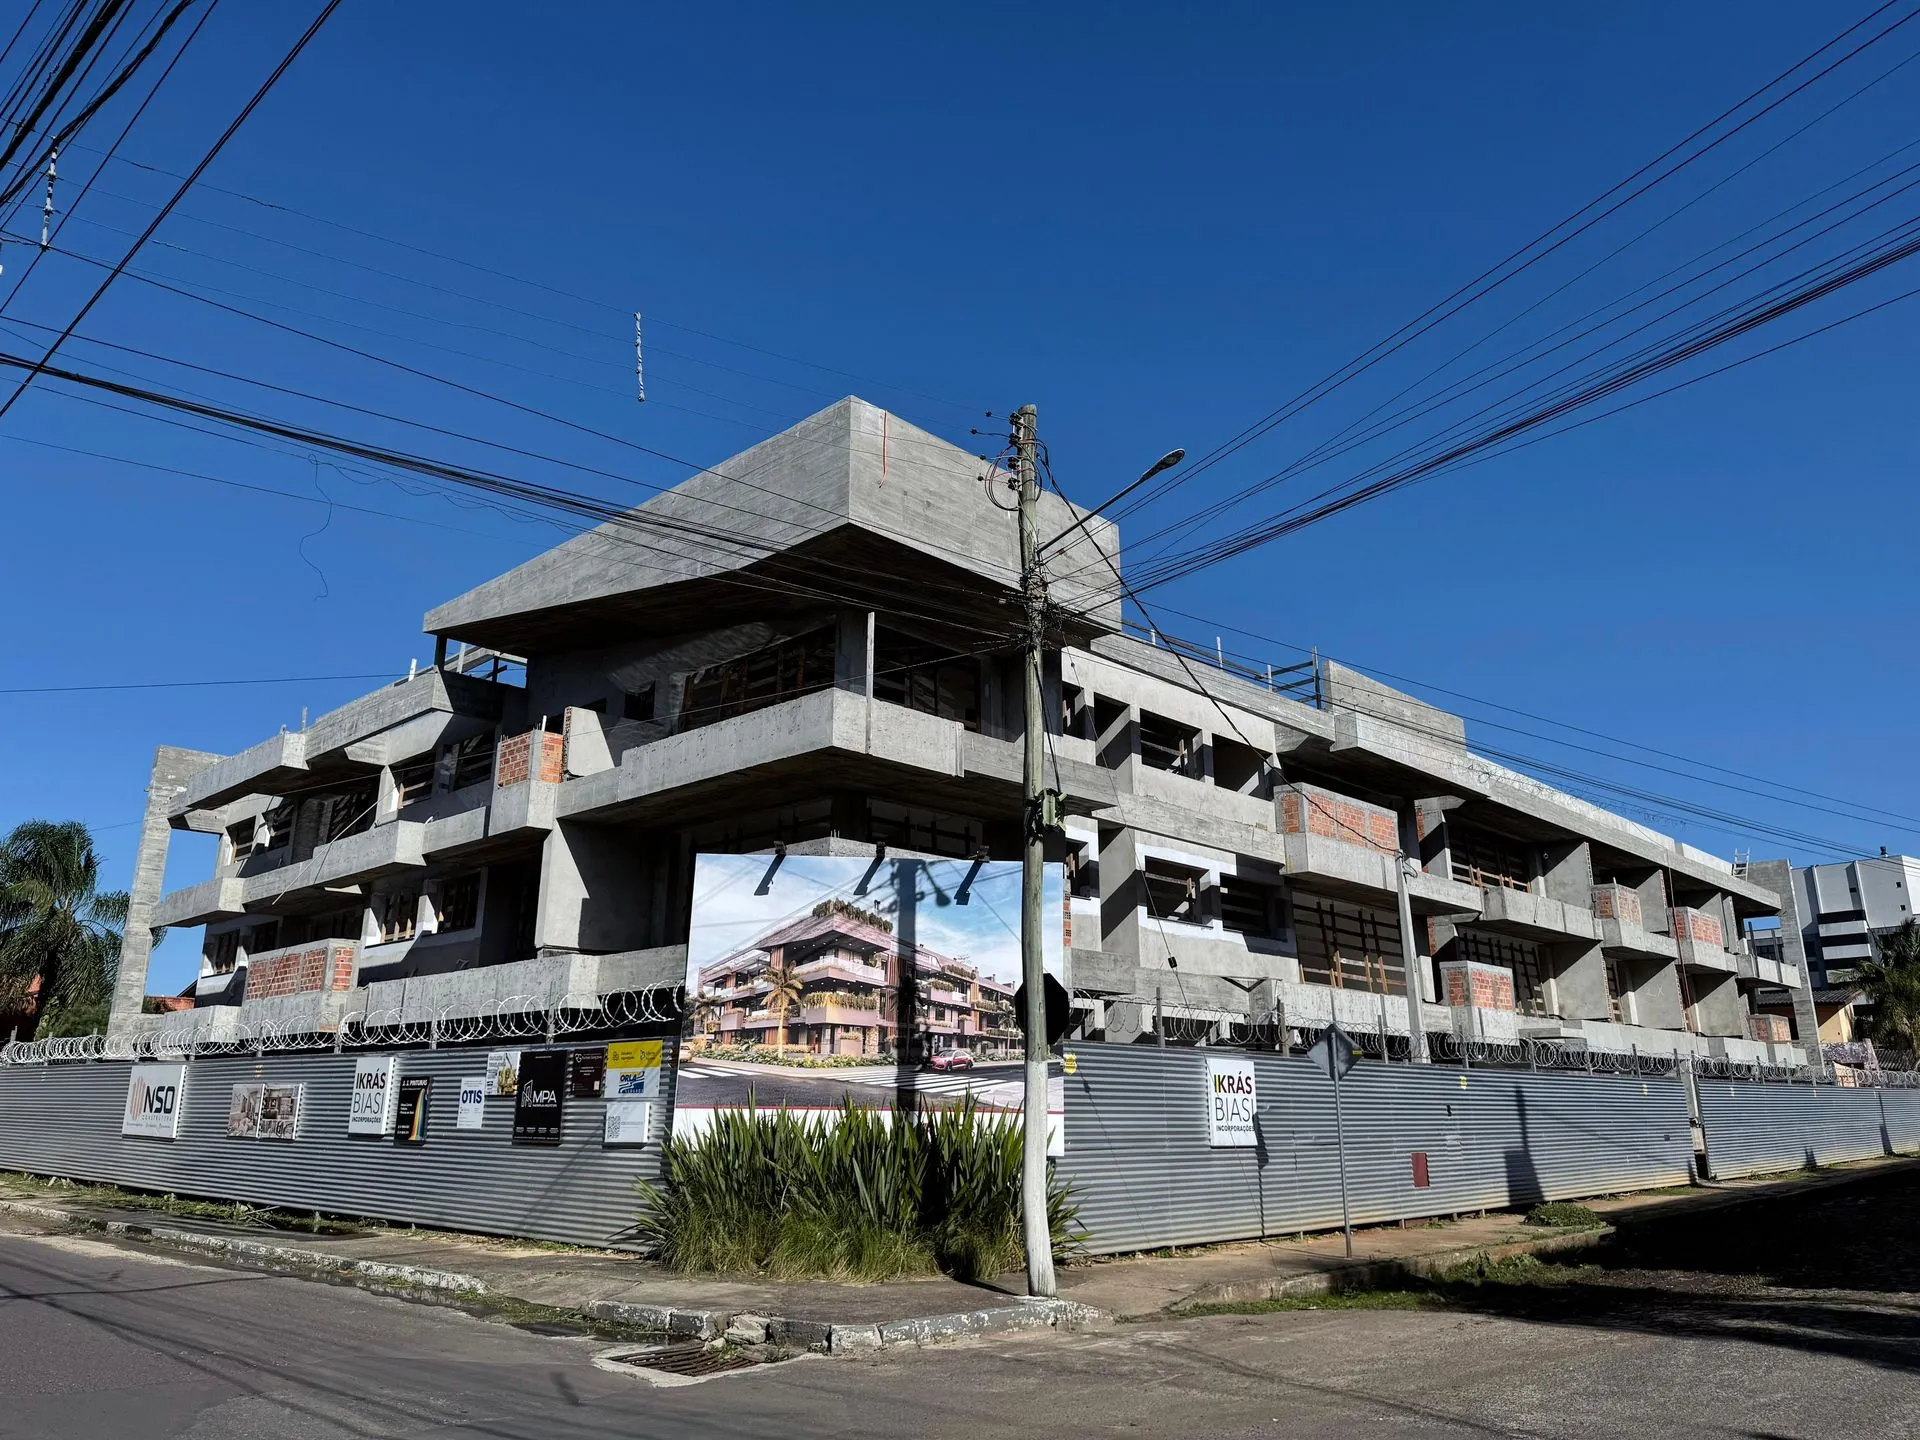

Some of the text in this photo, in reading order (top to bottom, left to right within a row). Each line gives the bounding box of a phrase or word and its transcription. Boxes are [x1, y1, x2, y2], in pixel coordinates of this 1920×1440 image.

[355, 1068, 386, 1089] IKRÁS
[620, 1074, 637, 1082] ORLA
[1214, 1070, 1252, 1094] IKRÁS
[143, 1085, 175, 1114] NSO
[353, 1092, 385, 1114] BIASI
[462, 1089, 482, 1104] OTIS
[532, 1090, 557, 1103] MPA
[1215, 1097, 1254, 1122] BIASI
[352, 1116, 382, 1124] INCORPORAÇÕES
[1216, 1124, 1255, 1133] INCORPORAÇÕES
